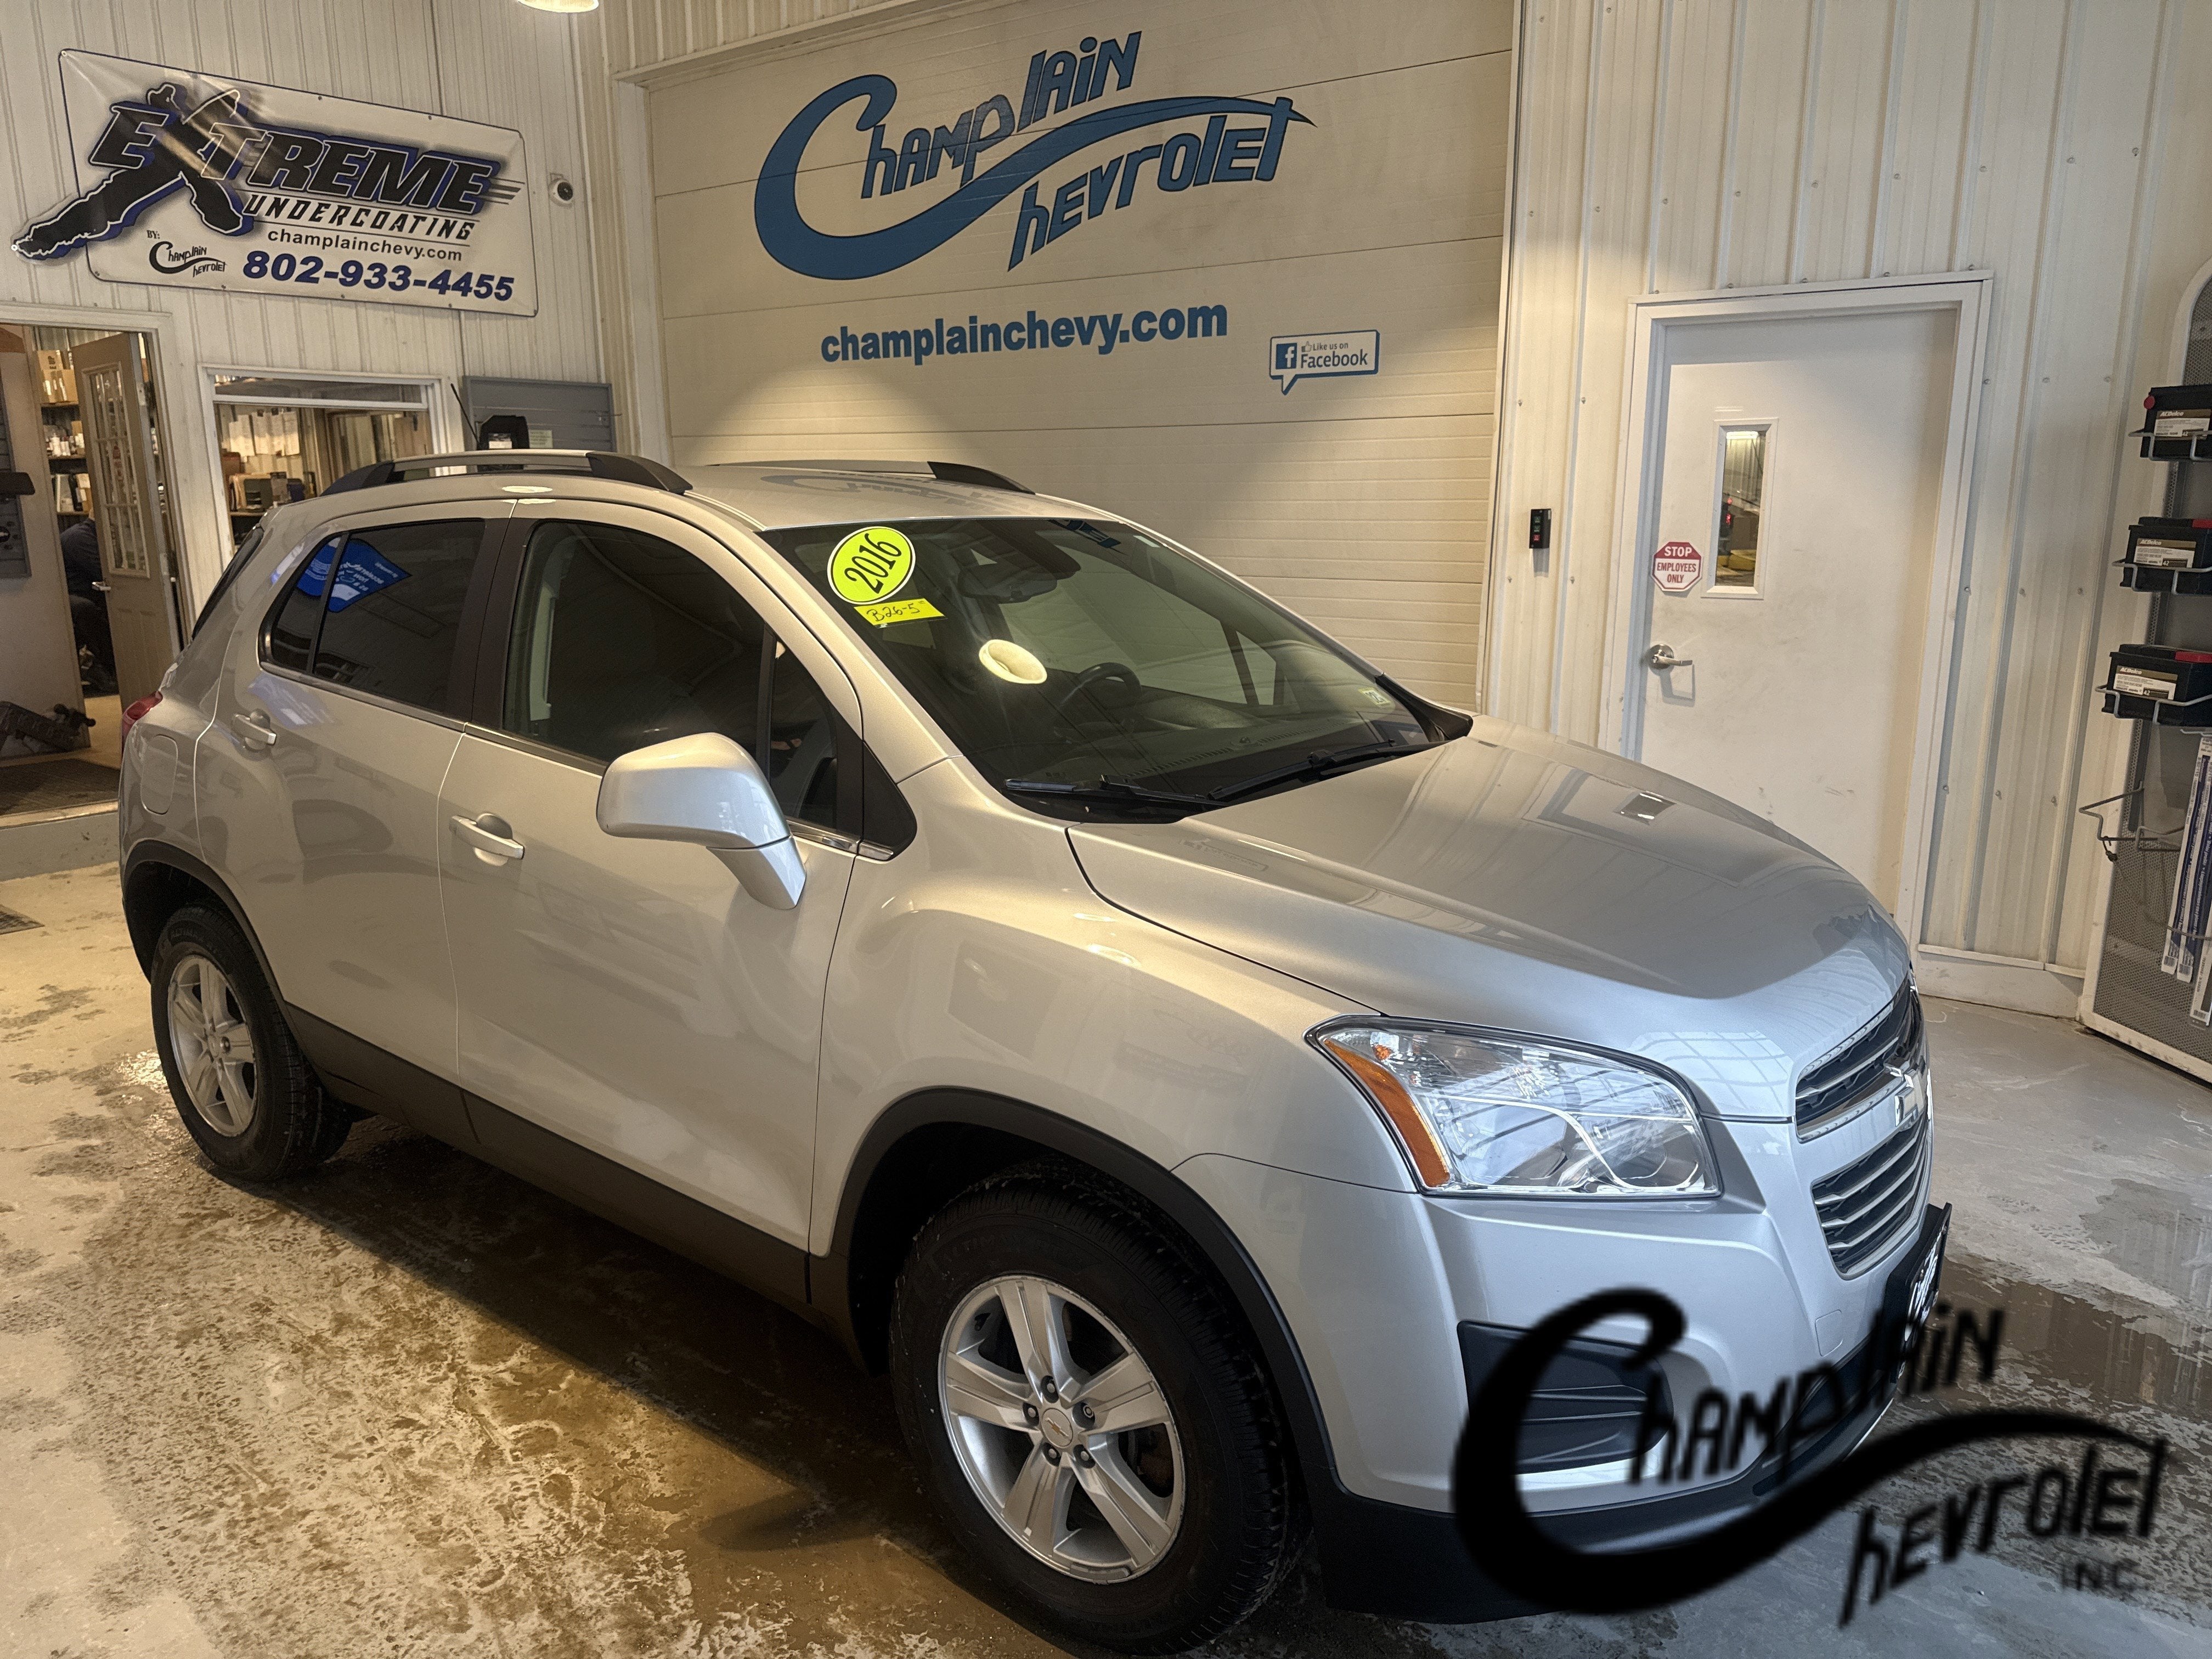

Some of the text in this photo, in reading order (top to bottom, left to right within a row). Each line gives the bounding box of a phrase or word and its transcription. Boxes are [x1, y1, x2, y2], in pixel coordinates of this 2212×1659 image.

[242, 194, 476, 240] UNDERCOATING
[146, 230, 161, 239] BY:
[268, 228, 462, 262] champlainchevy.com
[242, 250, 515, 302] 802-933-4455
[821, 304, 1228, 366] champlainchevy.com
[1312, 342, 1328, 351] Like
[1301, 348, 1368, 369] Facebook
[1664, 546, 1692, 557] STOP
[844, 533, 902, 594] 2016
[1657, 562, 1696, 573] EMPLOYEES
[1667, 573, 1684, 583] ONLY
